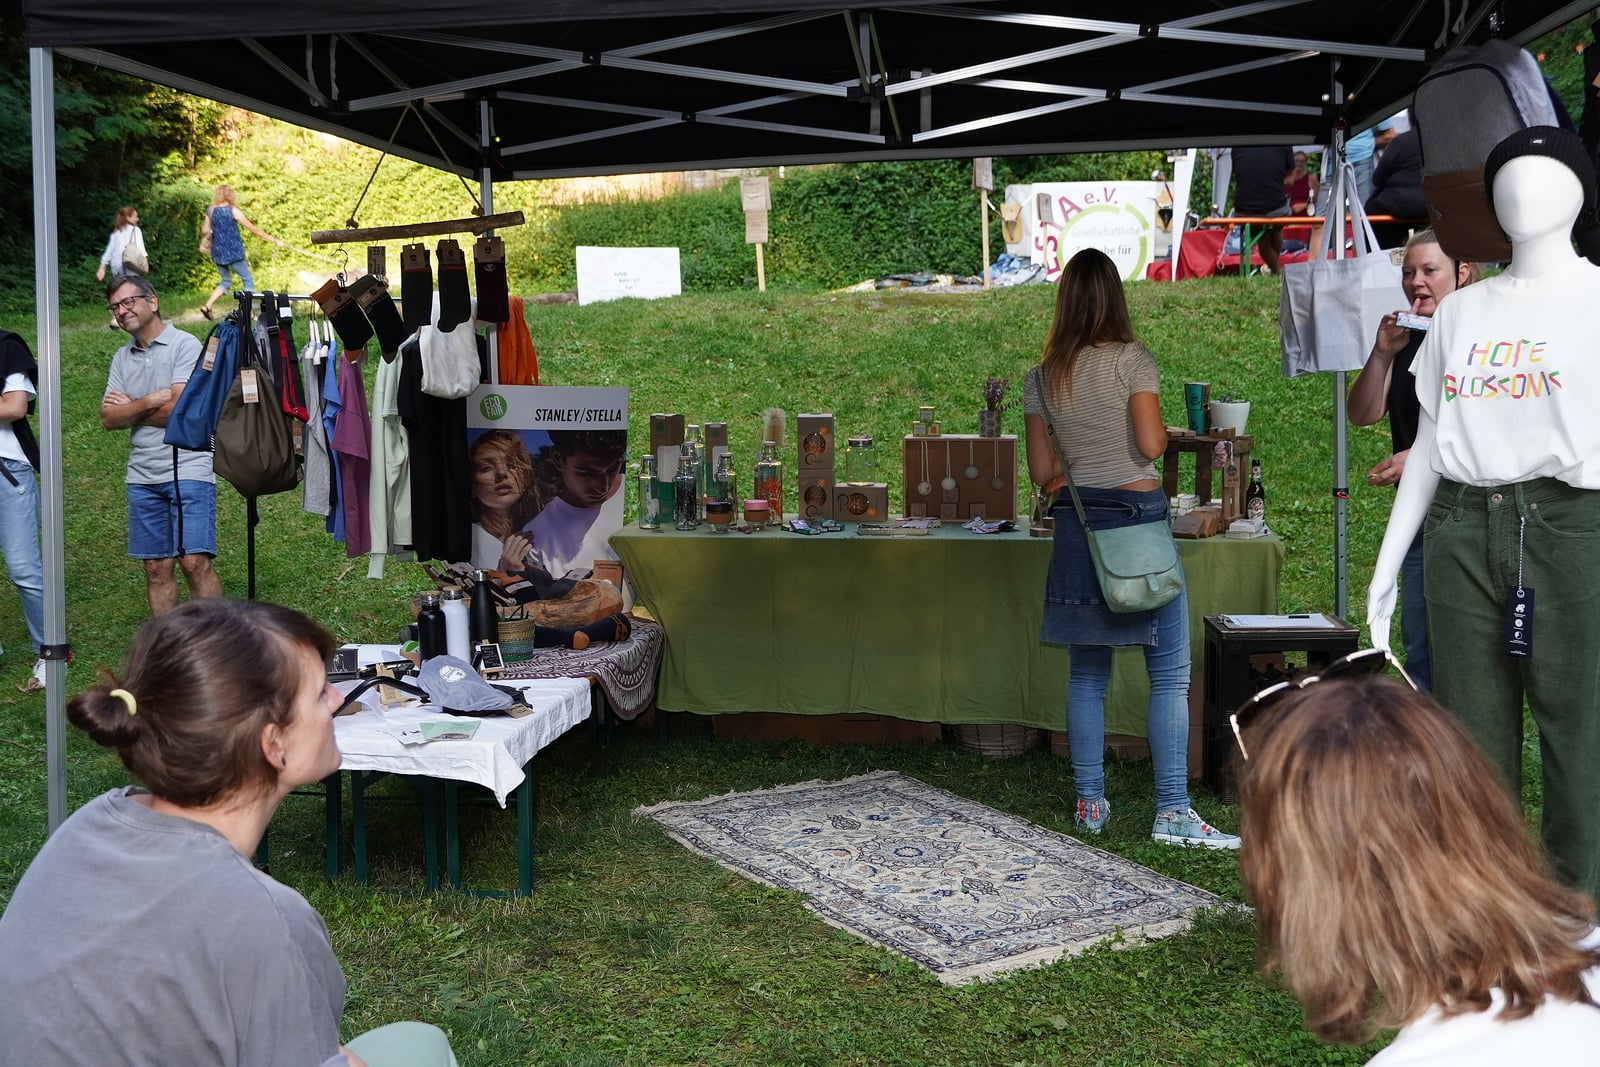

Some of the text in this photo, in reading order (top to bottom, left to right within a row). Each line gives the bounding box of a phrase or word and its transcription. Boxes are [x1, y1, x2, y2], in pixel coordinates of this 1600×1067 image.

[1466, 339, 1547, 367] HOPE
[1443, 371, 1562, 403] BLOSSOMS
[483, 396, 501, 409] ECO
[486, 406, 504, 418] FAIR
[535, 408, 622, 424] STANLEY/STELLA
